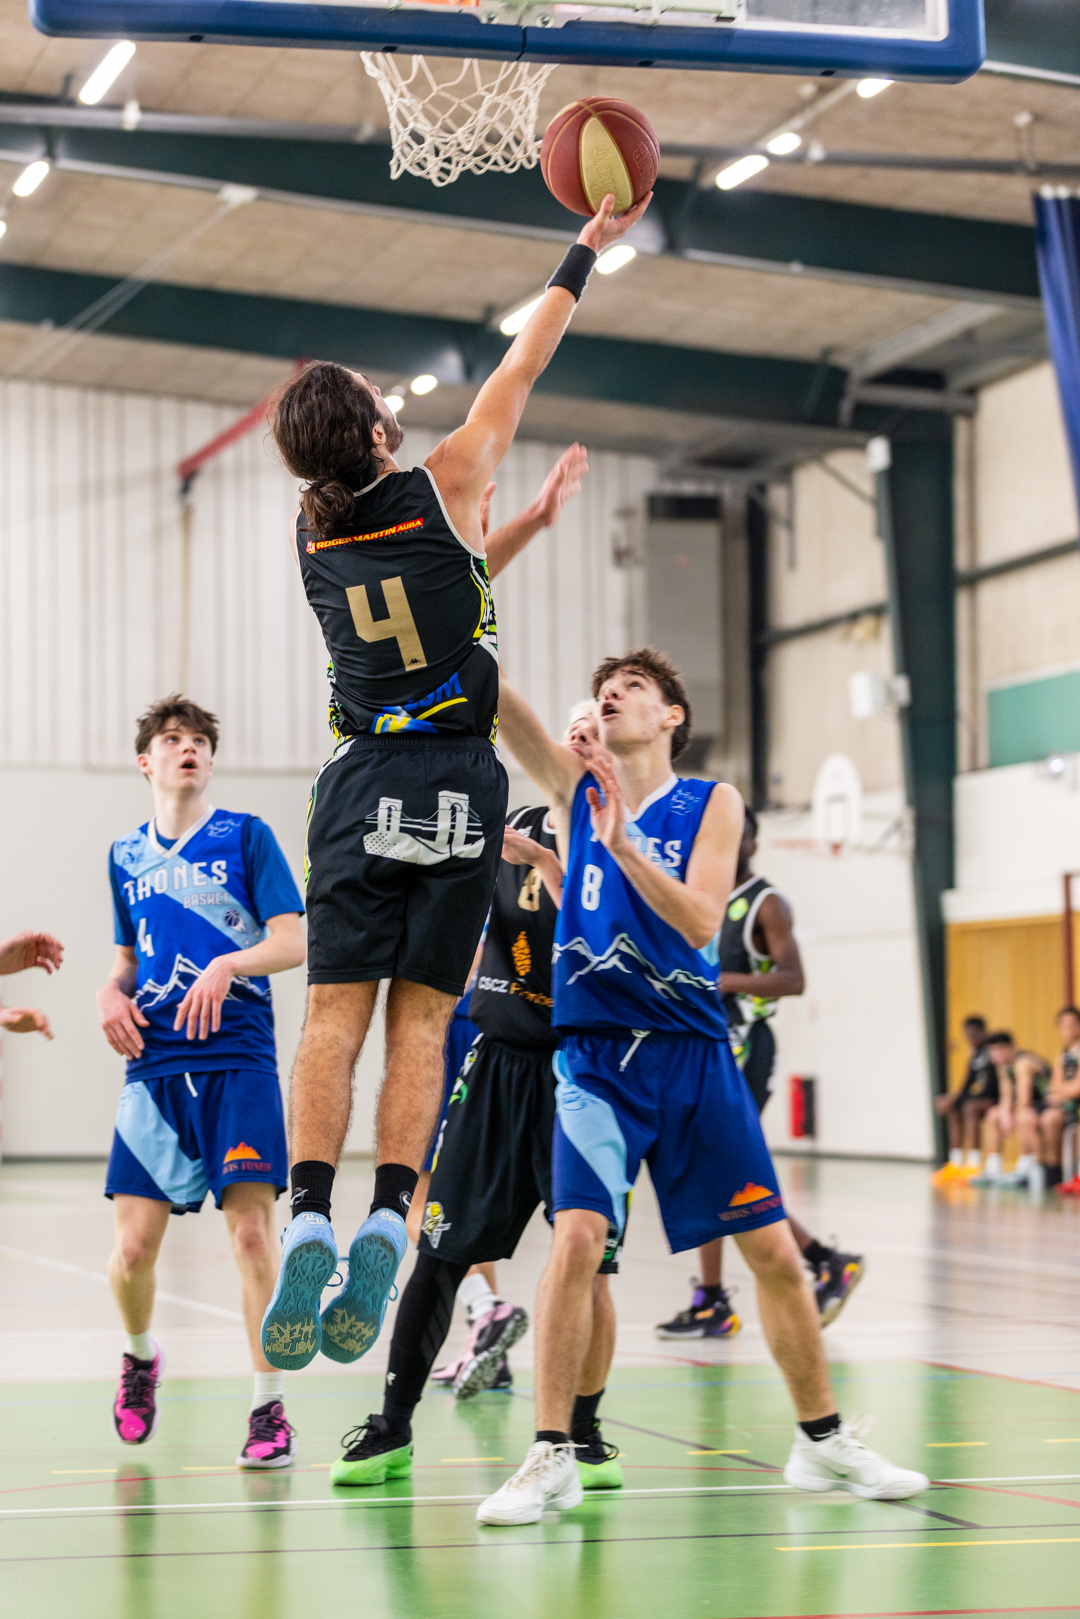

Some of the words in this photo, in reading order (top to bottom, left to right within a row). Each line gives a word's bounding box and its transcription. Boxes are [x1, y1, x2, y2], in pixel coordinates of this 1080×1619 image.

[316, 537, 352, 549] ROGER
[353, 526, 396, 542] MARTIN
[397, 520, 422, 532] AURA
[345, 576, 427, 671] 4
[183, 892, 230, 909] BASKET
[580, 864, 604, 911] 8
[138, 918, 155, 957] 4
[265, 1318, 316, 1344] HERE
[264, 1338, 293, 1356] FROM
[290, 1337, 317, 1356] NOT
